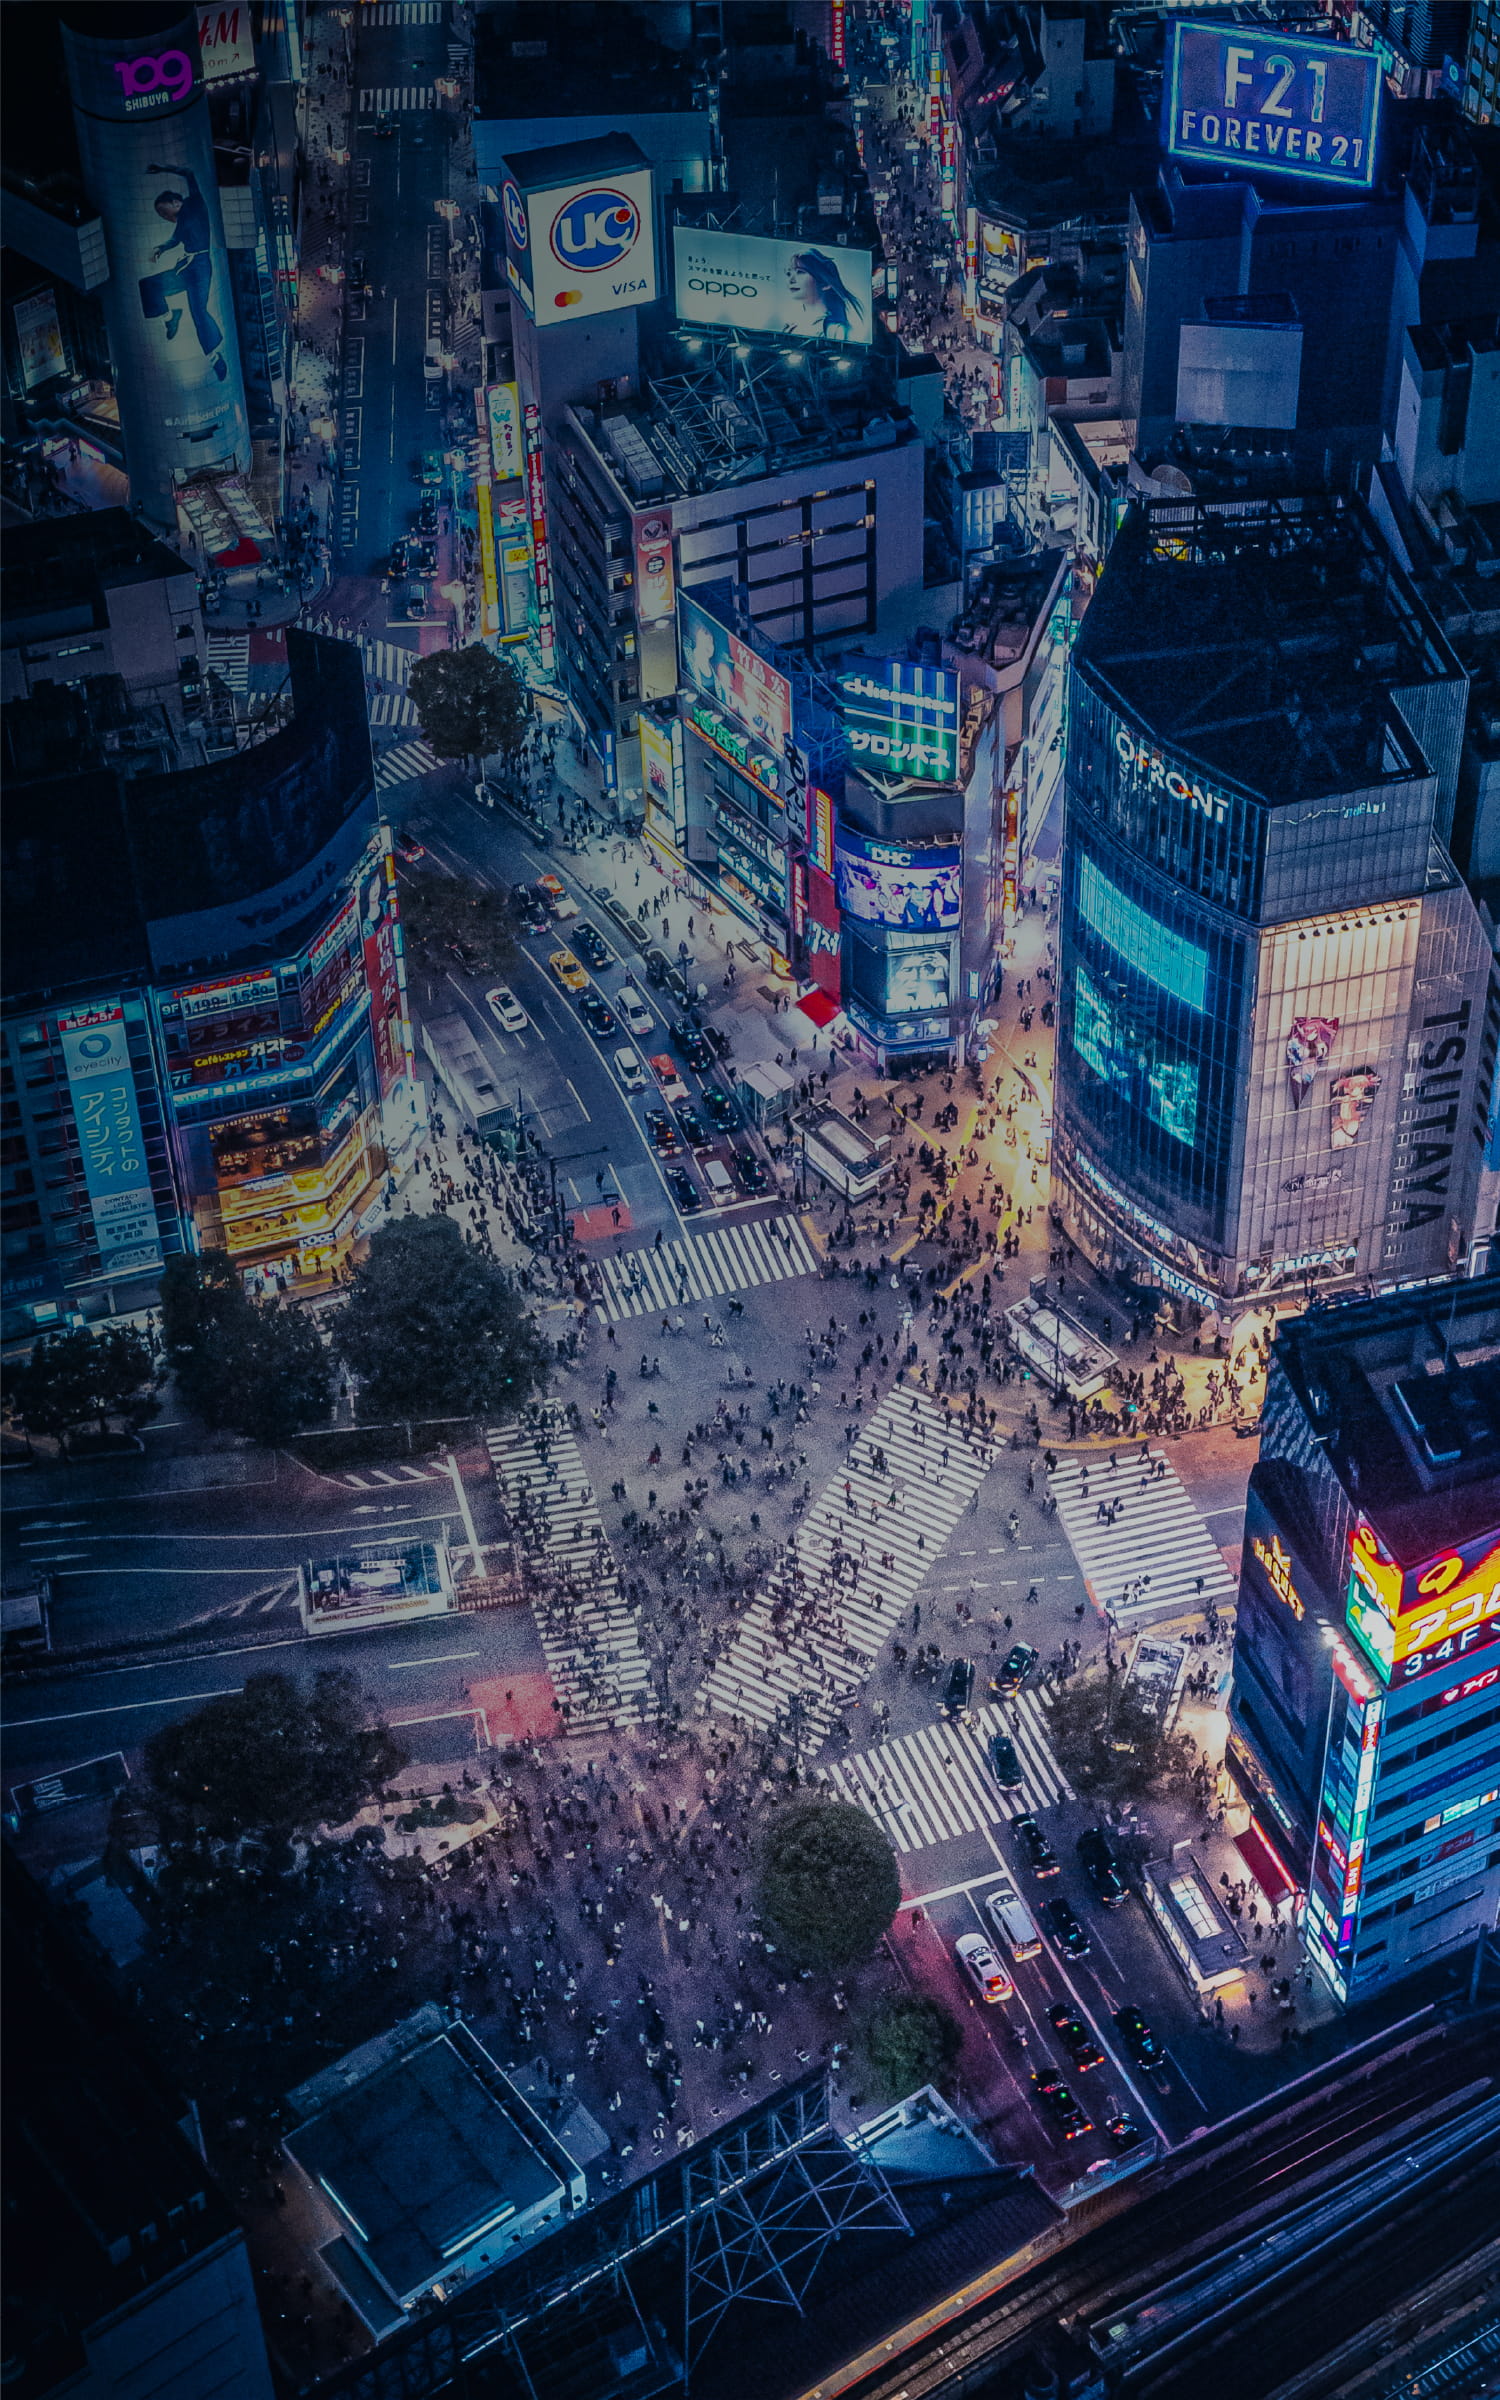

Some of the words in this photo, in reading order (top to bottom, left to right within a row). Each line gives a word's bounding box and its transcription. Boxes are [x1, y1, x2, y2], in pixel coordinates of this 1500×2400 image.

[114, 50, 193, 102] 109
[1224, 46, 1328, 124] F21
[124, 91, 169, 112] SHIBUYA
[1181, 110, 1323, 162] FOREVER
[1331, 134, 1364, 168] 21
[561, 206, 631, 254] UC
[612, 279, 647, 295] VISA
[688, 278, 757, 297] oppo
[848, 730, 951, 769] サロンパス
[1116, 731, 1229, 824] QFRONT
[870, 846, 912, 867] DHC
[162, 1003, 179, 1016] 9F
[74, 1056, 122, 1074] eyecity
[79, 1091, 116, 1176] アイシティ
[110, 1087, 140, 1172] コンタクトの
[1400, 1000, 1472, 1231] TSUTAYA
[1151, 1260, 1217, 1312] TSUTAYA
[1271, 1246, 1359, 1279] TSUTAYA
